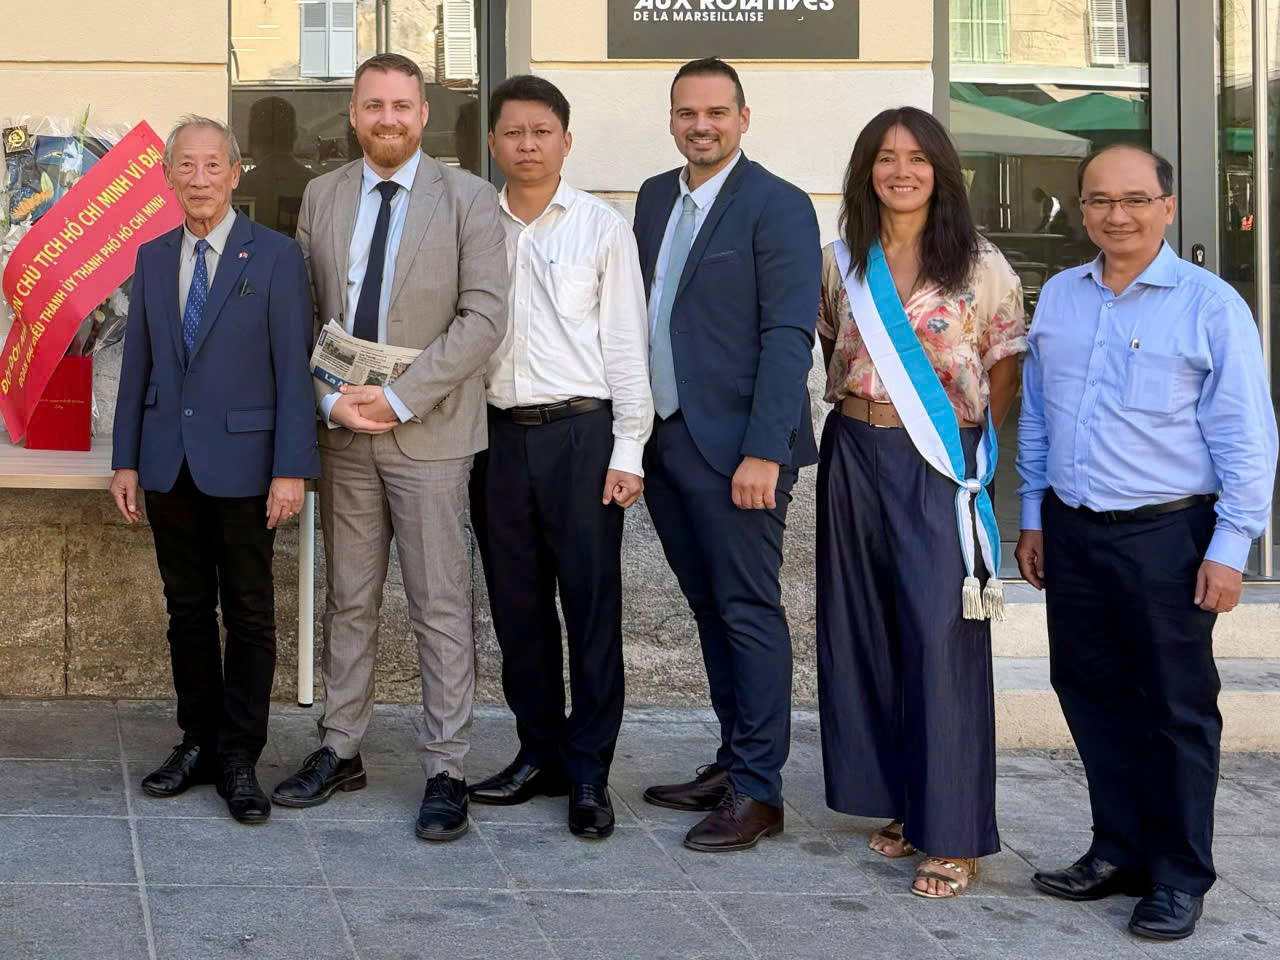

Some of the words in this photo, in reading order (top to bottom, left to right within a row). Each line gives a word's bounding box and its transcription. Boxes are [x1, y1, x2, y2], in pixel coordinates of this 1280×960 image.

[633, 12, 649, 21] DE
[653, 12, 669, 21] LA
[673, 12, 764, 22] MARSEILLAISE
[16, 263, 41, 296] CHỦ
[33, 237, 67, 267] TỊCH
[59, 217, 84, 244] HỒ
[78, 199, 104, 226] CHÍ
[96, 174, 134, 208] MINH
[40, 289, 68, 322] THÀNH
[73, 253, 105, 280] THÀNH
[100, 234, 121, 258] PHỐ
[116, 224, 133, 242] HỒ
[129, 210, 148, 229] CHÍ
[142, 194, 166, 217] MINH
